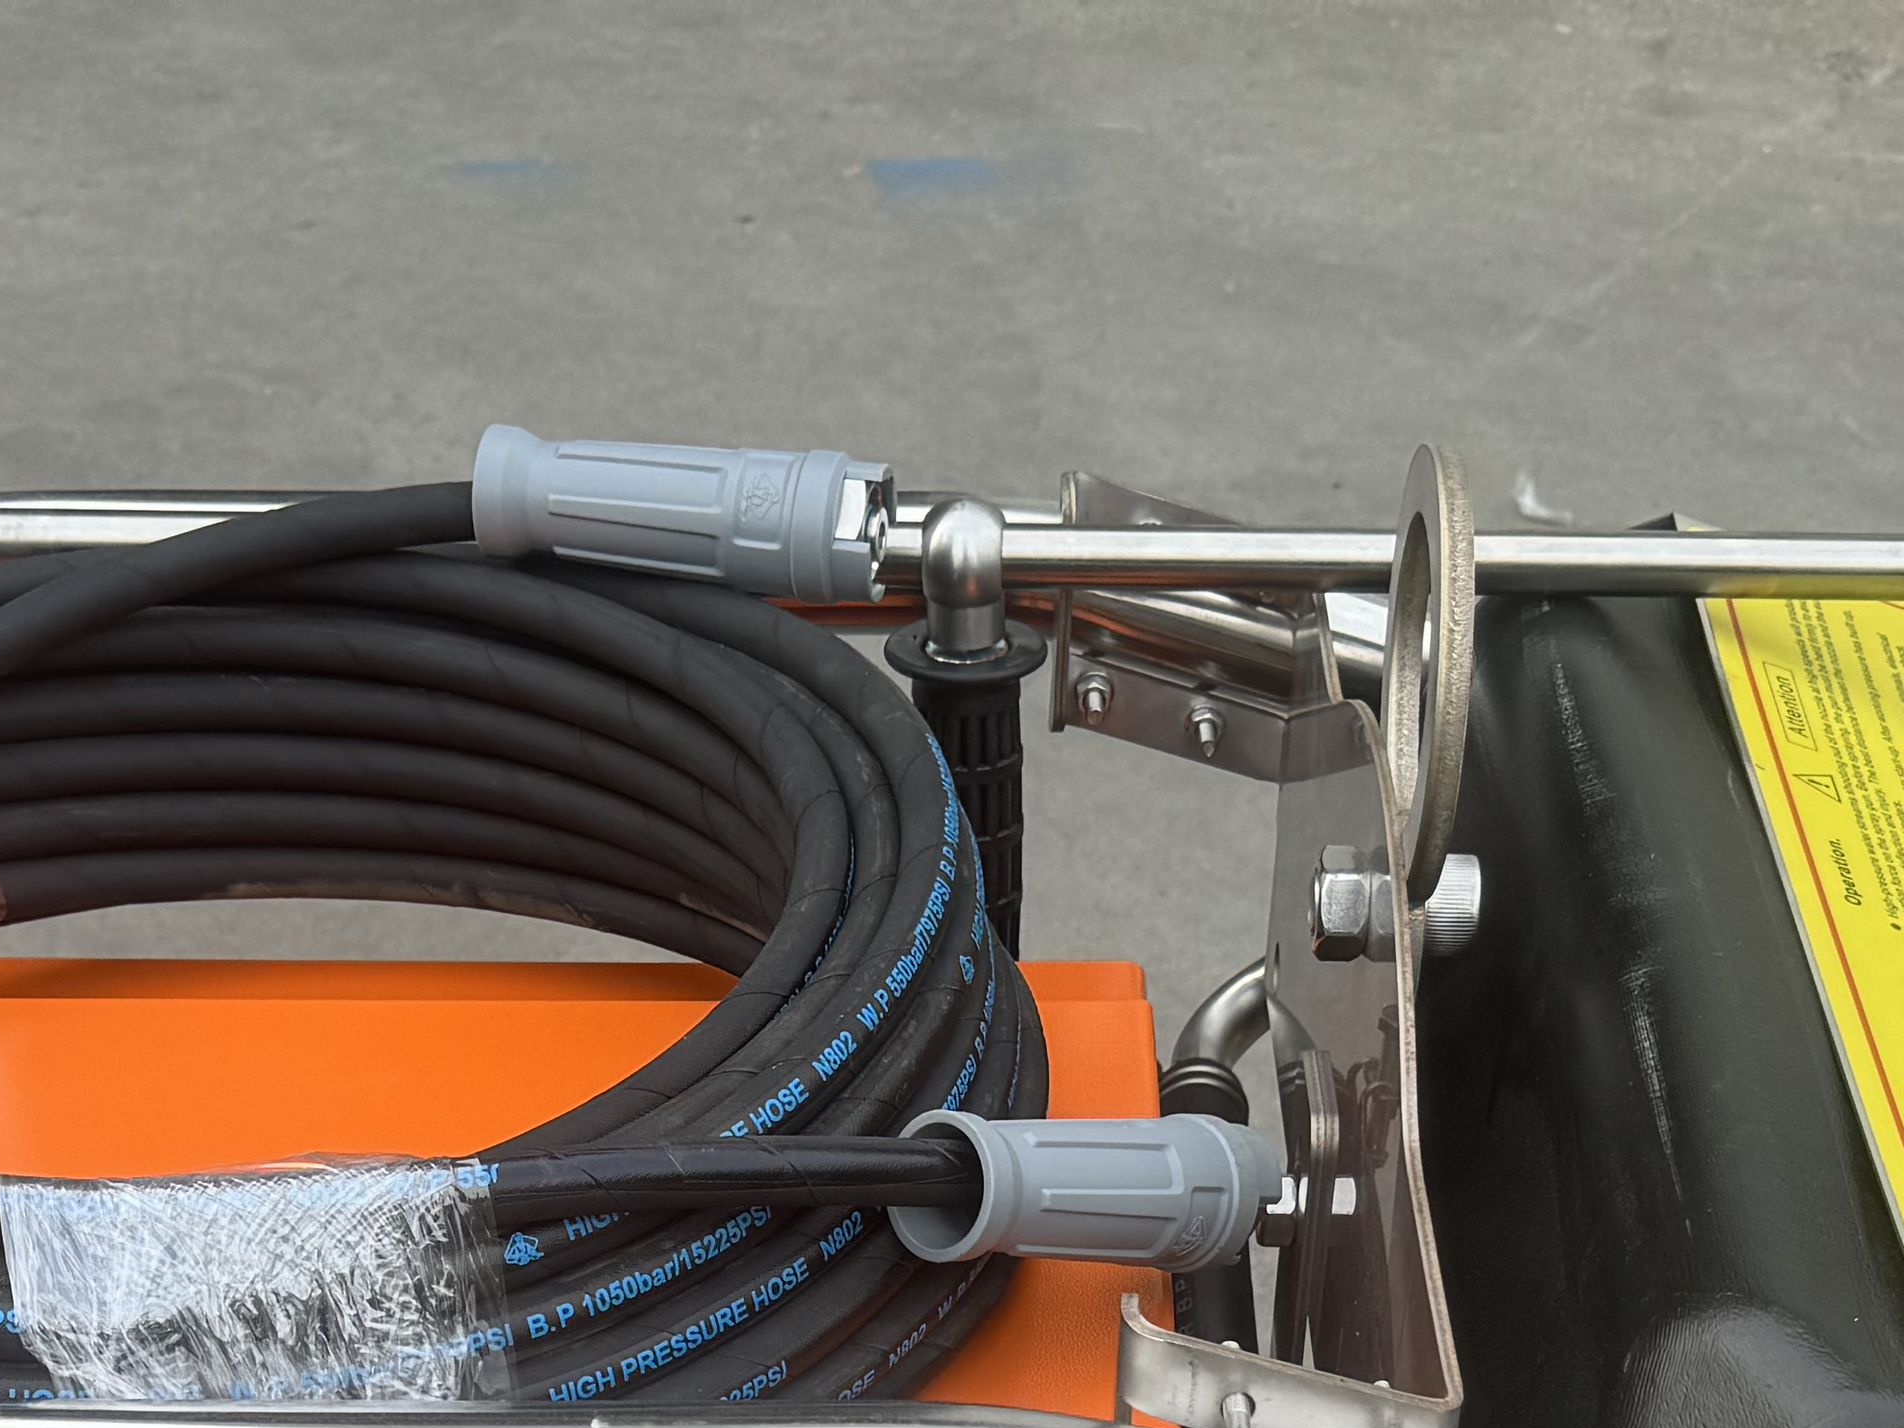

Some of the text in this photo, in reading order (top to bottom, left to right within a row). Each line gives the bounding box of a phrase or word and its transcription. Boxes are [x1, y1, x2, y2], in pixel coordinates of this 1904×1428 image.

[1776, 675, 1807, 738] Attention
[1829, 838, 1862, 905] Operation.
[750, 1077, 810, 1137] HOSE
[811, 1029, 858, 1082] N802
[856, 989, 891, 1032] W.P
[885, 876, 952, 999] 550bar/7975PSI
[528, 1206, 772, 1340] B.P 1050bar/15225PSI
[549, 1367, 616, 1401] HIGH
[621, 1297, 747, 1382] PRESSURE
[752, 1257, 809, 1314] HOSE
[820, 1212, 863, 1261] N802
